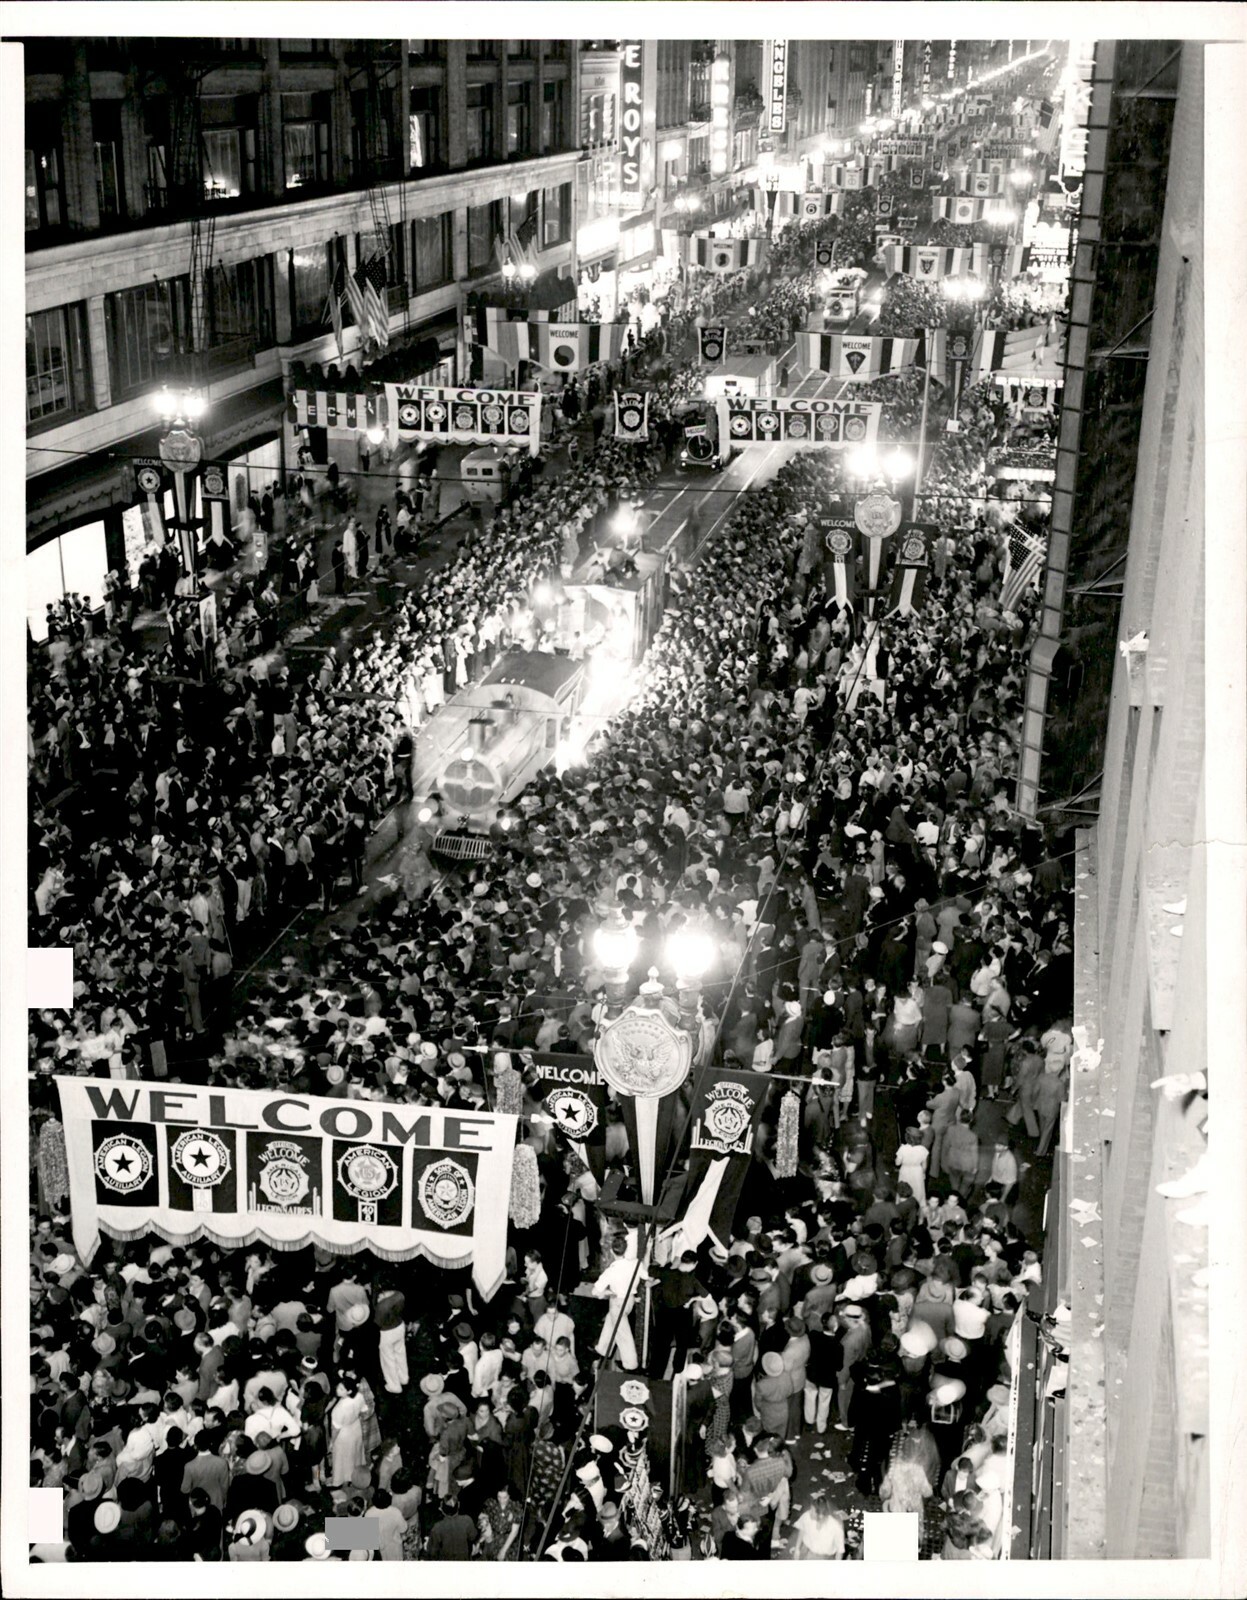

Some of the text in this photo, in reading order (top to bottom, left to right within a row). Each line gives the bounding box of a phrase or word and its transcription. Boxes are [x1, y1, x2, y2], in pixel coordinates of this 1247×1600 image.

[550, 330, 579, 339] WELCOME
[842, 341, 871, 350] WELCOME
[395, 386, 536, 406] WELCOME
[727, 398, 873, 415] WELCOME
[820, 519, 856, 528] WELCOME
[535, 1065, 606, 1085] WELCOME
[705, 1087, 756, 1110] WELCOME
[85, 1086, 494, 1151] WELCOME
[98, 1138, 149, 1173] AMERICAN LEGION
[174, 1133, 227, 1167] AMERICAN LEGION
[258, 1148, 310, 1167] WELCOME
[344, 1148, 392, 1170] AMERICAN
[181, 1169, 221, 1183] AUXILIARY
[433, 1164, 464, 1179] SONS OF
[104, 1175, 143, 1189] AUXILIARY
[347, 1182, 388, 1199] LEGION
[361, 1205, 374, 1216] 40
[426, 1197, 459, 1221] AMERICAN
[456, 1189, 468, 1213] LEGION
